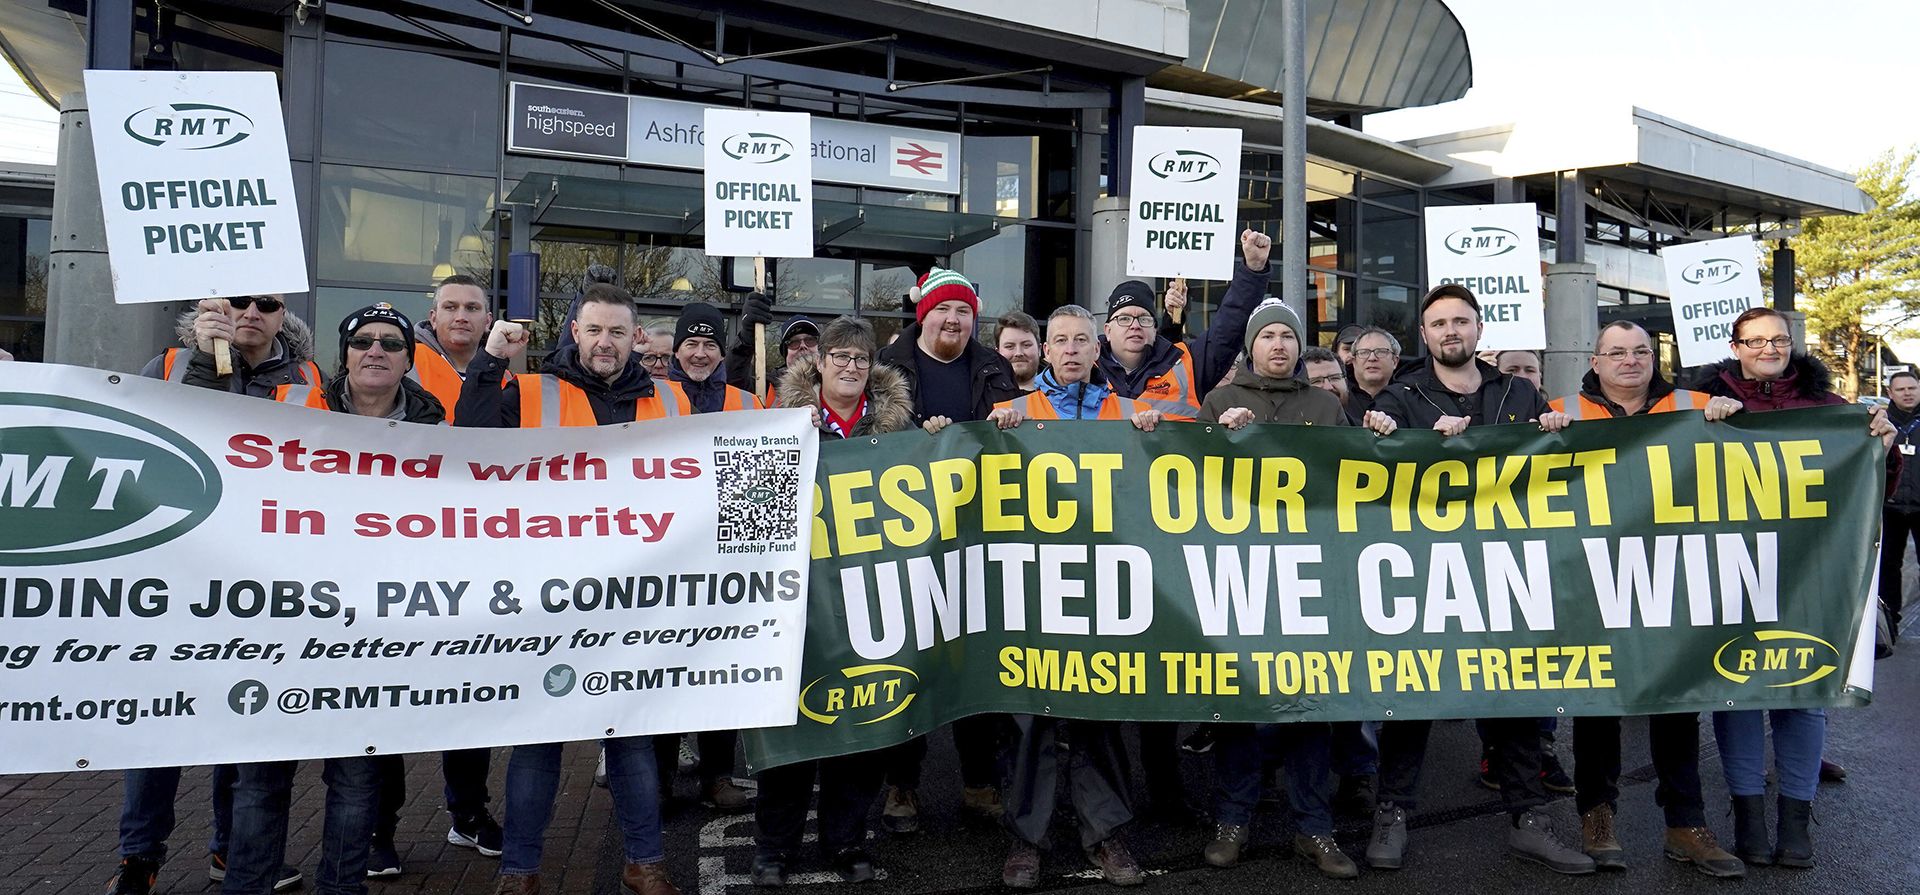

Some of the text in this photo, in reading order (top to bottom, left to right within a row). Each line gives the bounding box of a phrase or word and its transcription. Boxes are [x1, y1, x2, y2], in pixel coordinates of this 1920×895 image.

[154, 117, 231, 137] RMT
[527, 113, 616, 138] highspeed
[737, 141, 781, 155] RMT
[1164, 160, 1209, 174] RMT
[121, 178, 277, 211] OFFICIAL
[715, 181, 801, 202] OFFICIAL
[724, 210, 793, 230] PICKET
[1139, 201, 1224, 223] OFFICIAL
[144, 221, 266, 255] PICKET
[1146, 230, 1215, 251] PICKET
[1461, 235, 1506, 249] RMT
[1695, 265, 1731, 279] RMT
[1693, 322, 1734, 342] PICK
[713, 435, 799, 448] Medway Branch
[225, 433, 702, 482] Stand with us
[1149, 454, 1308, 534] OUR
[1337, 448, 1616, 533] PICKET
[1646, 439, 1827, 524] LINE
[261, 500, 675, 543] in solidarity
[717, 542, 796, 555] Hardship Fund
[0, 570, 801, 628] DING JOBS, PAY & CONDITIONS
[840, 532, 1779, 660] UNITED WE CAN WIN
[52, 639, 122, 662] for
[129, 643, 158, 661] a
[170, 638, 289, 664] safer,
[301, 637, 425, 661] better
[430, 632, 559, 657] railway
[569, 628, 614, 649] for
[999, 645, 1616, 695] SMASH THE TORY PAY FREEZE
[1738, 647, 1815, 672] RMT
[582, 664, 783, 695] @RMTunion
[277, 682, 520, 714] @RMTunion
[826, 678, 901, 713] RMT
